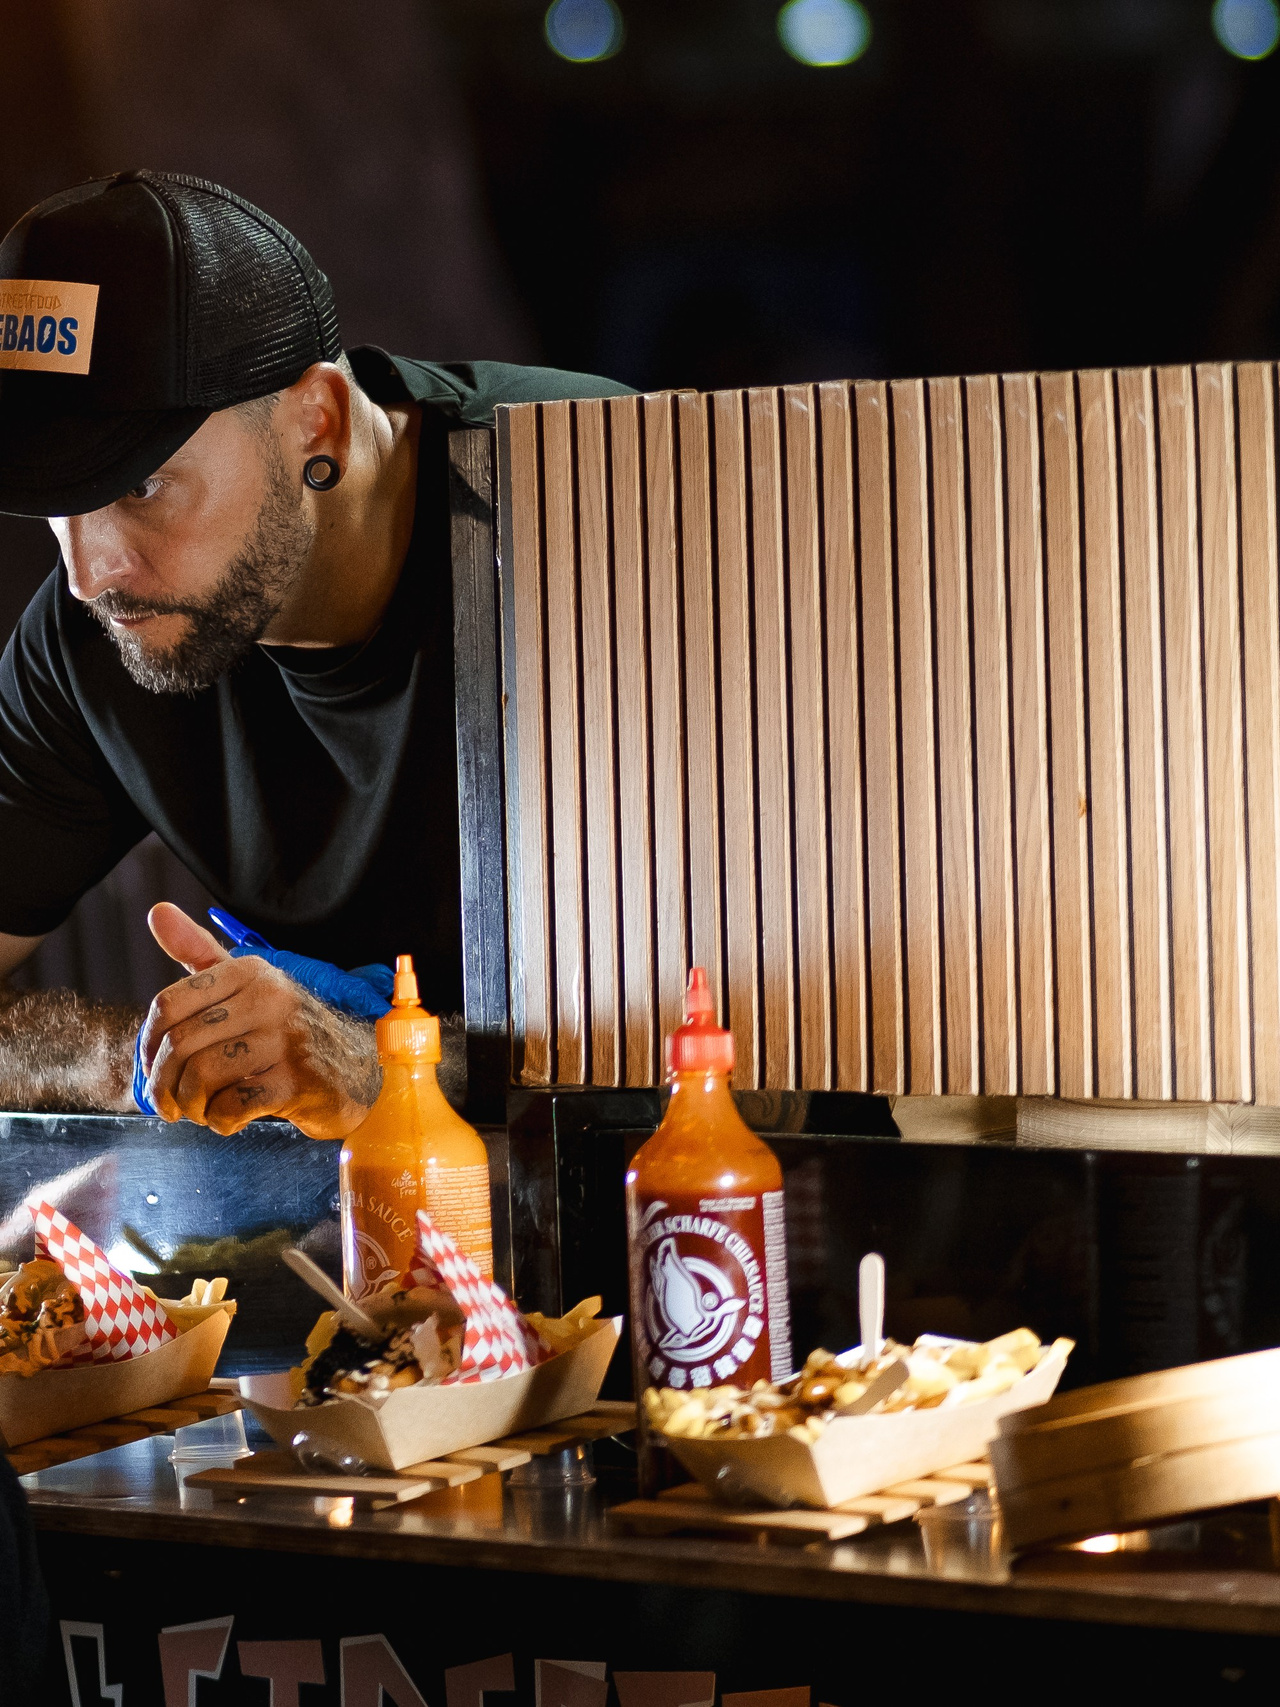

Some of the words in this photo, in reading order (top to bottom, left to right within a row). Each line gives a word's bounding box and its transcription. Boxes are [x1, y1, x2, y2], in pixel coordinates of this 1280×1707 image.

[391, 1176, 418, 1188] Gluten
[399, 1185, 417, 1199] Free
[367, 1196, 413, 1243] SAUCE
[664, 1214, 730, 1244] SCHARFE
